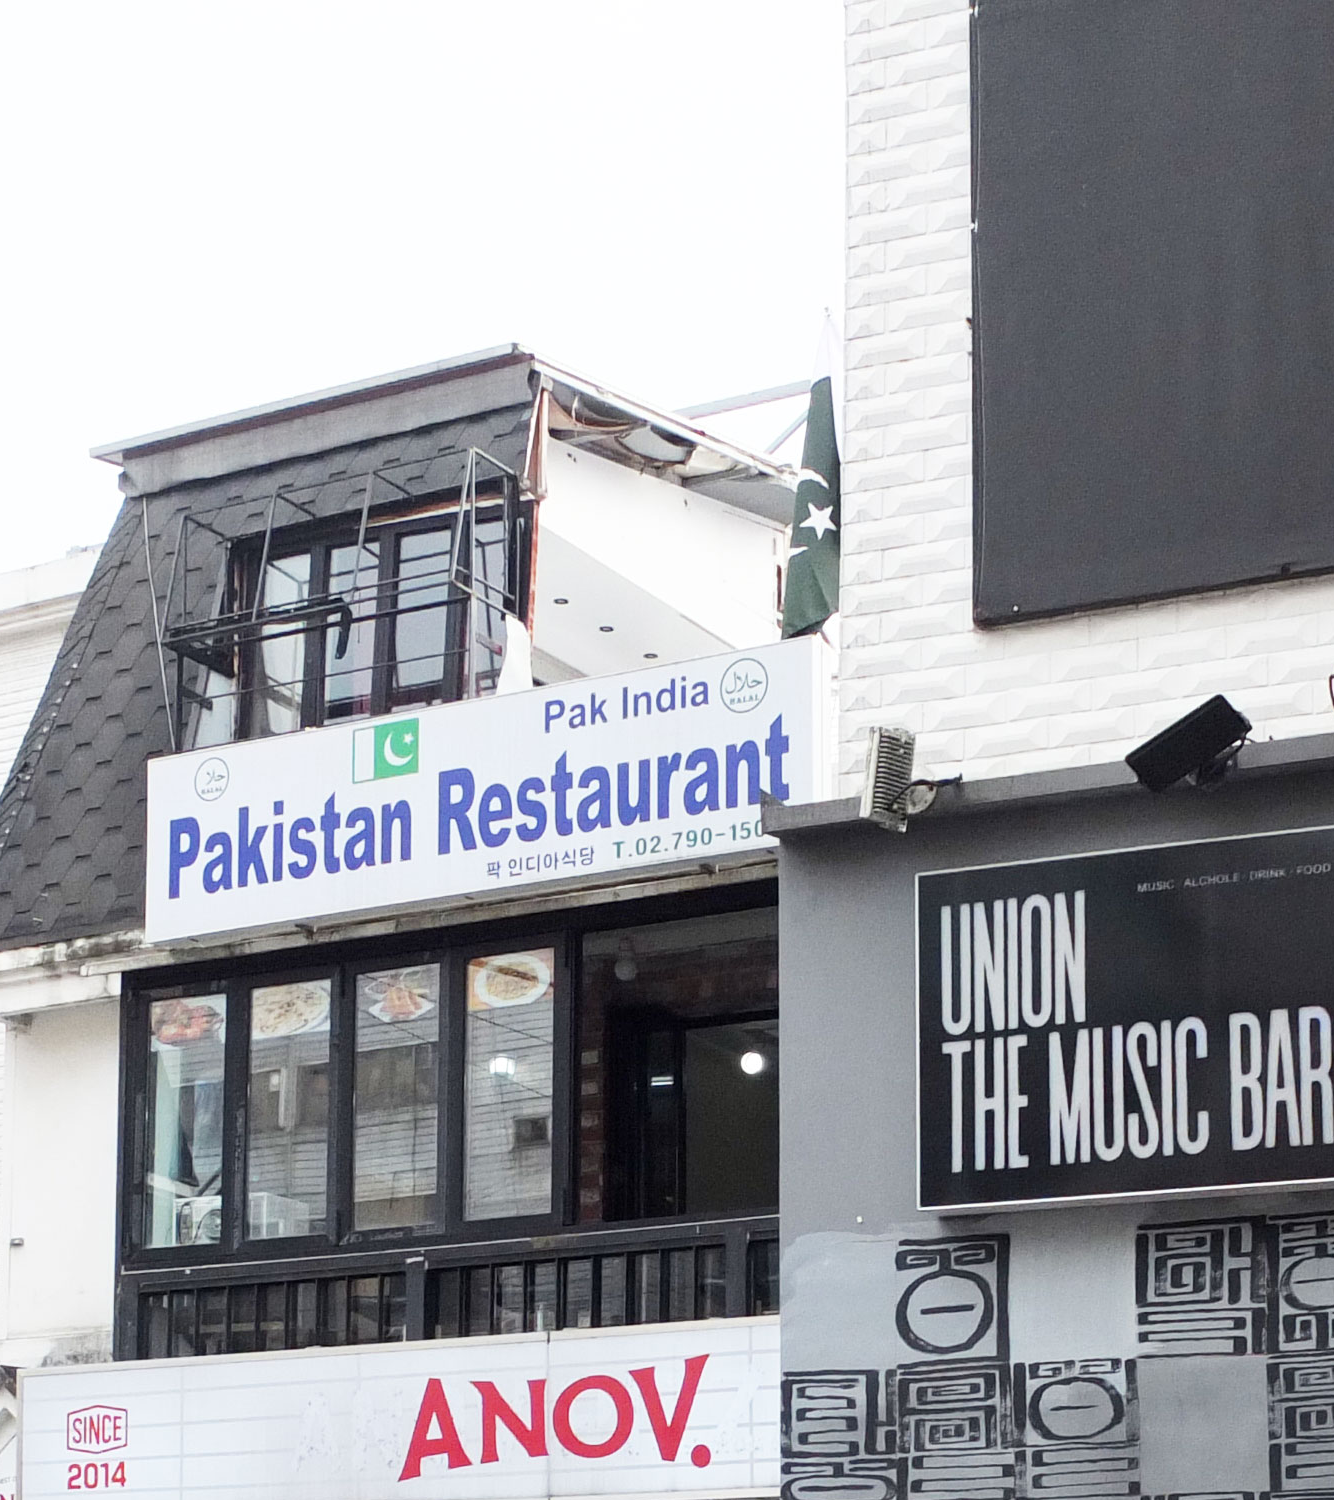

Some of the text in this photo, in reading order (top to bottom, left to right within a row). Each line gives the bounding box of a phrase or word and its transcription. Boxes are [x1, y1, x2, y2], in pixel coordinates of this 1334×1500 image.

[544, 675, 710, 734] Pak India
[729, 693, 760, 705] HALAL
[168, 713, 791, 899] Pakistan Restaurant
[507, 846, 595, 877] 인디아식당
[1296, 862, 1332, 875] FOOD
[940, 889, 1087, 1036] UNION
[941, 1005, 1334, 1174] THE MUSIC BAR
[72, 1414, 122, 1445] SINCE
[398, 1353, 711, 1483] ANOV.
[67, 1461, 127, 1490] 2014
